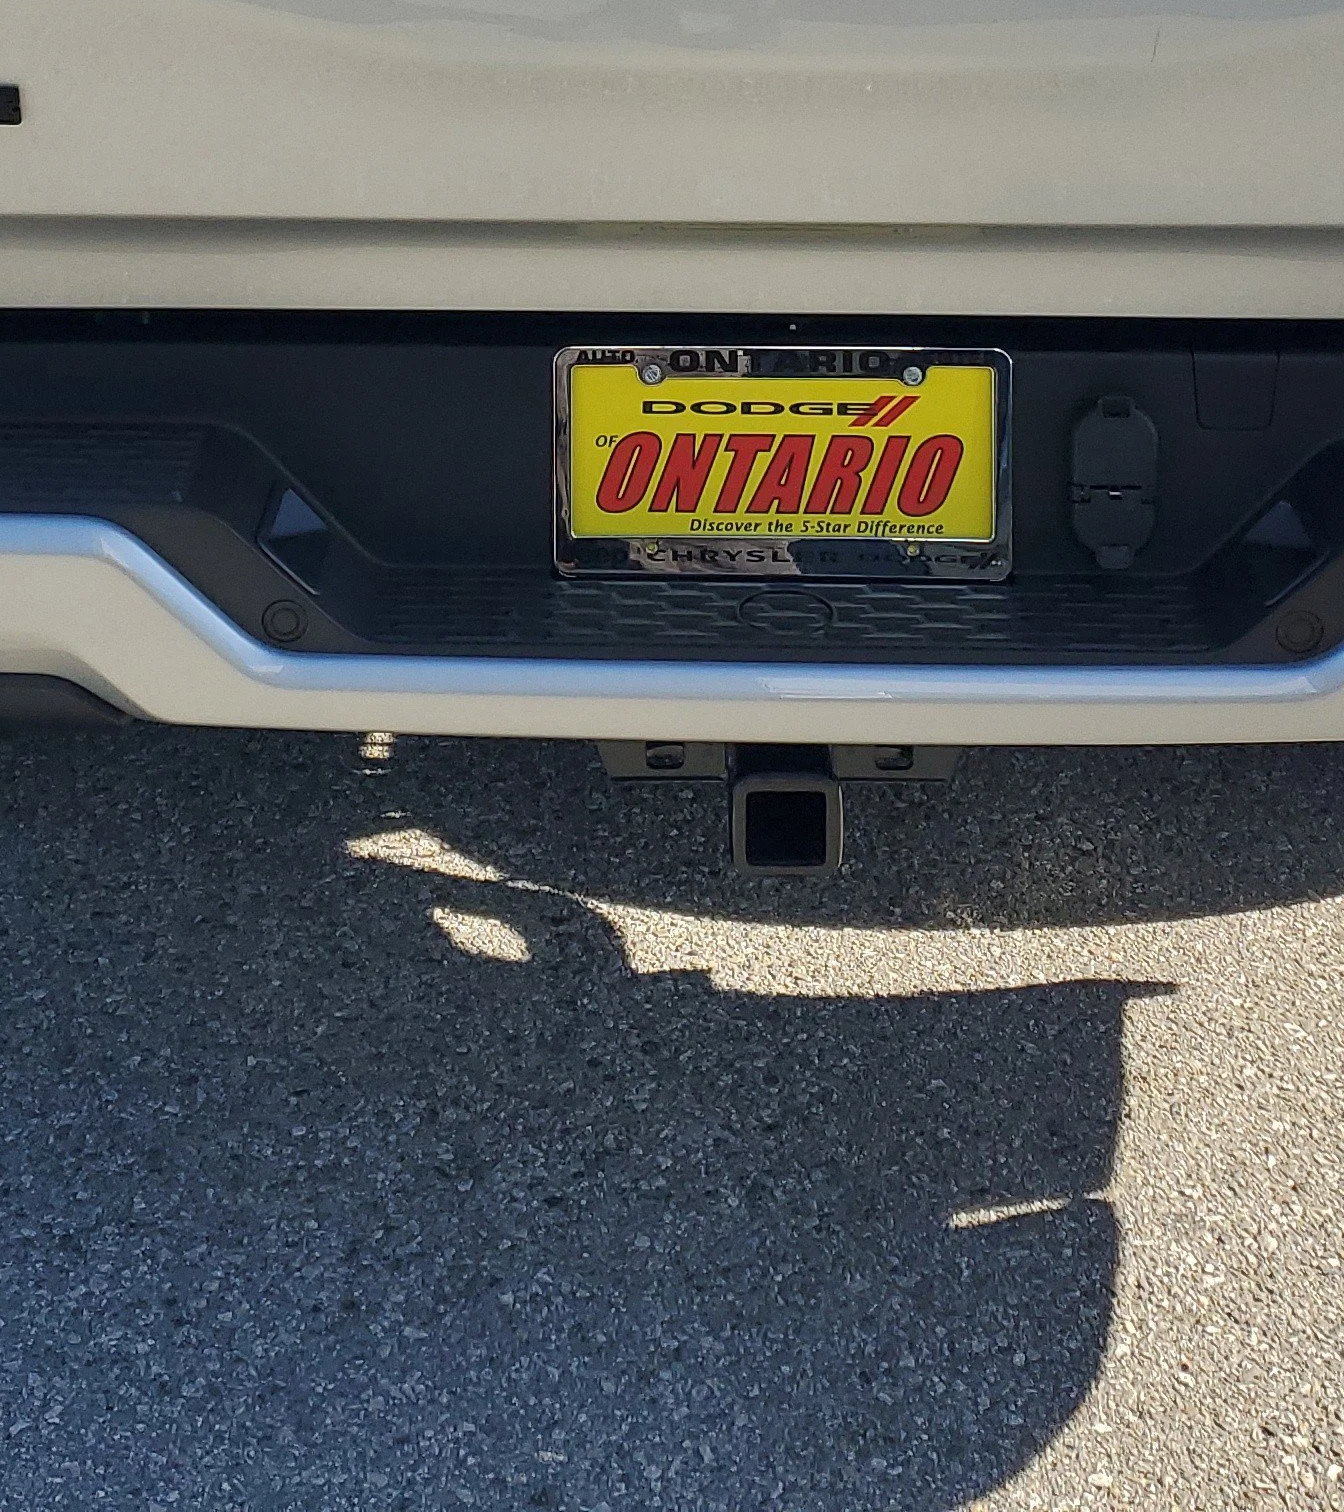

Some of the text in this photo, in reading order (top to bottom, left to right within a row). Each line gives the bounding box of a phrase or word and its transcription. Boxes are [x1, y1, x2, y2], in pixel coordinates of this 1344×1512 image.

[641, 400, 877, 417] DODGE
[595, 431, 964, 517] OF ONTARIO
[689, 518, 944, 538] Discover the 5-Star Difference
